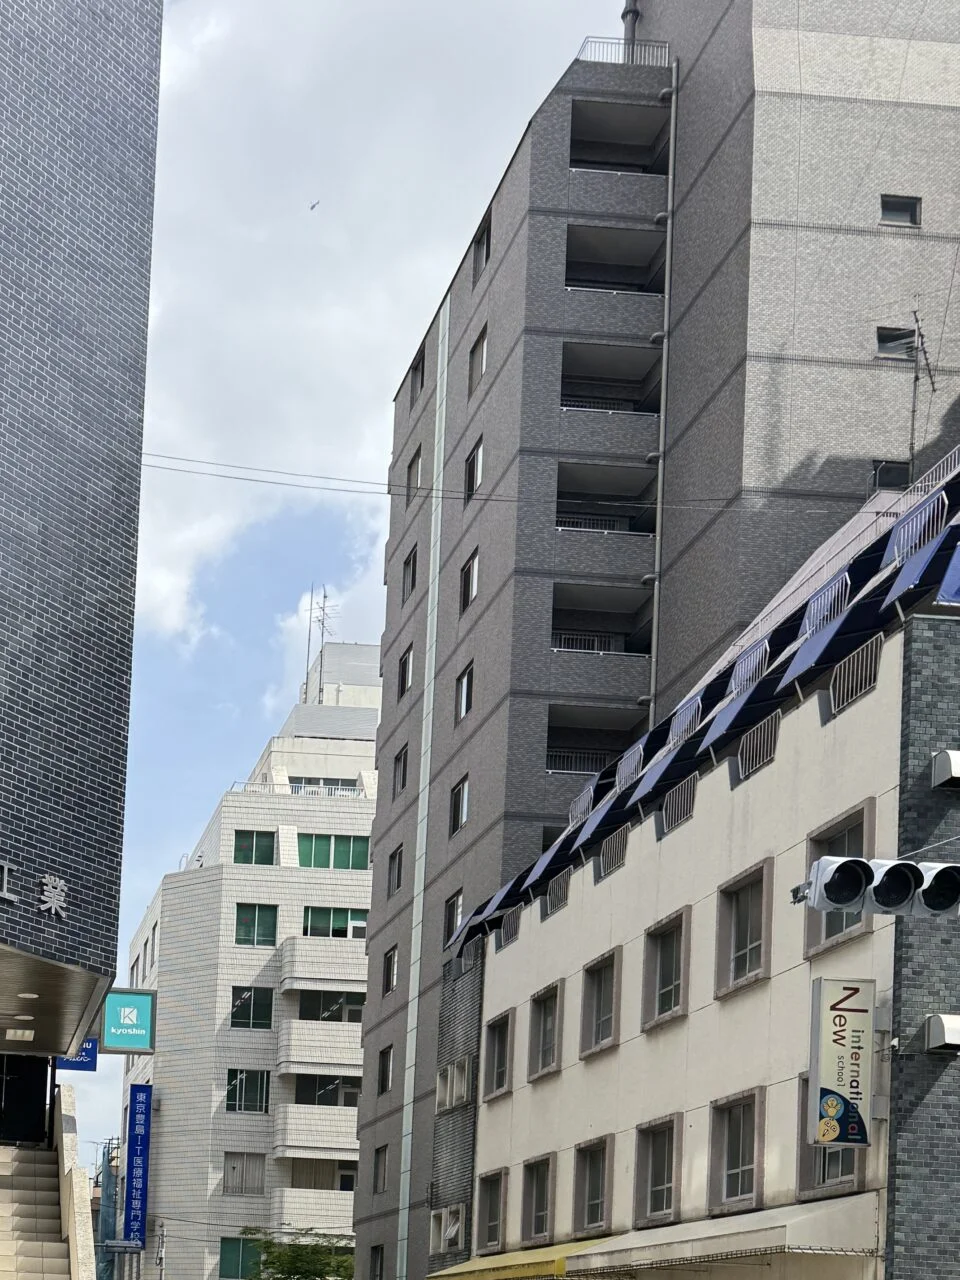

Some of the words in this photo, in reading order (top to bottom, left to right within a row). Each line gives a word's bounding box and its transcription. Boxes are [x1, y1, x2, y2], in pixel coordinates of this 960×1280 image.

[111, 1027, 146, 1035] kyoshin
[830, 986, 868, 1047] New
[837, 1055, 845, 1087] school
[848, 1029, 864, 1139] international
